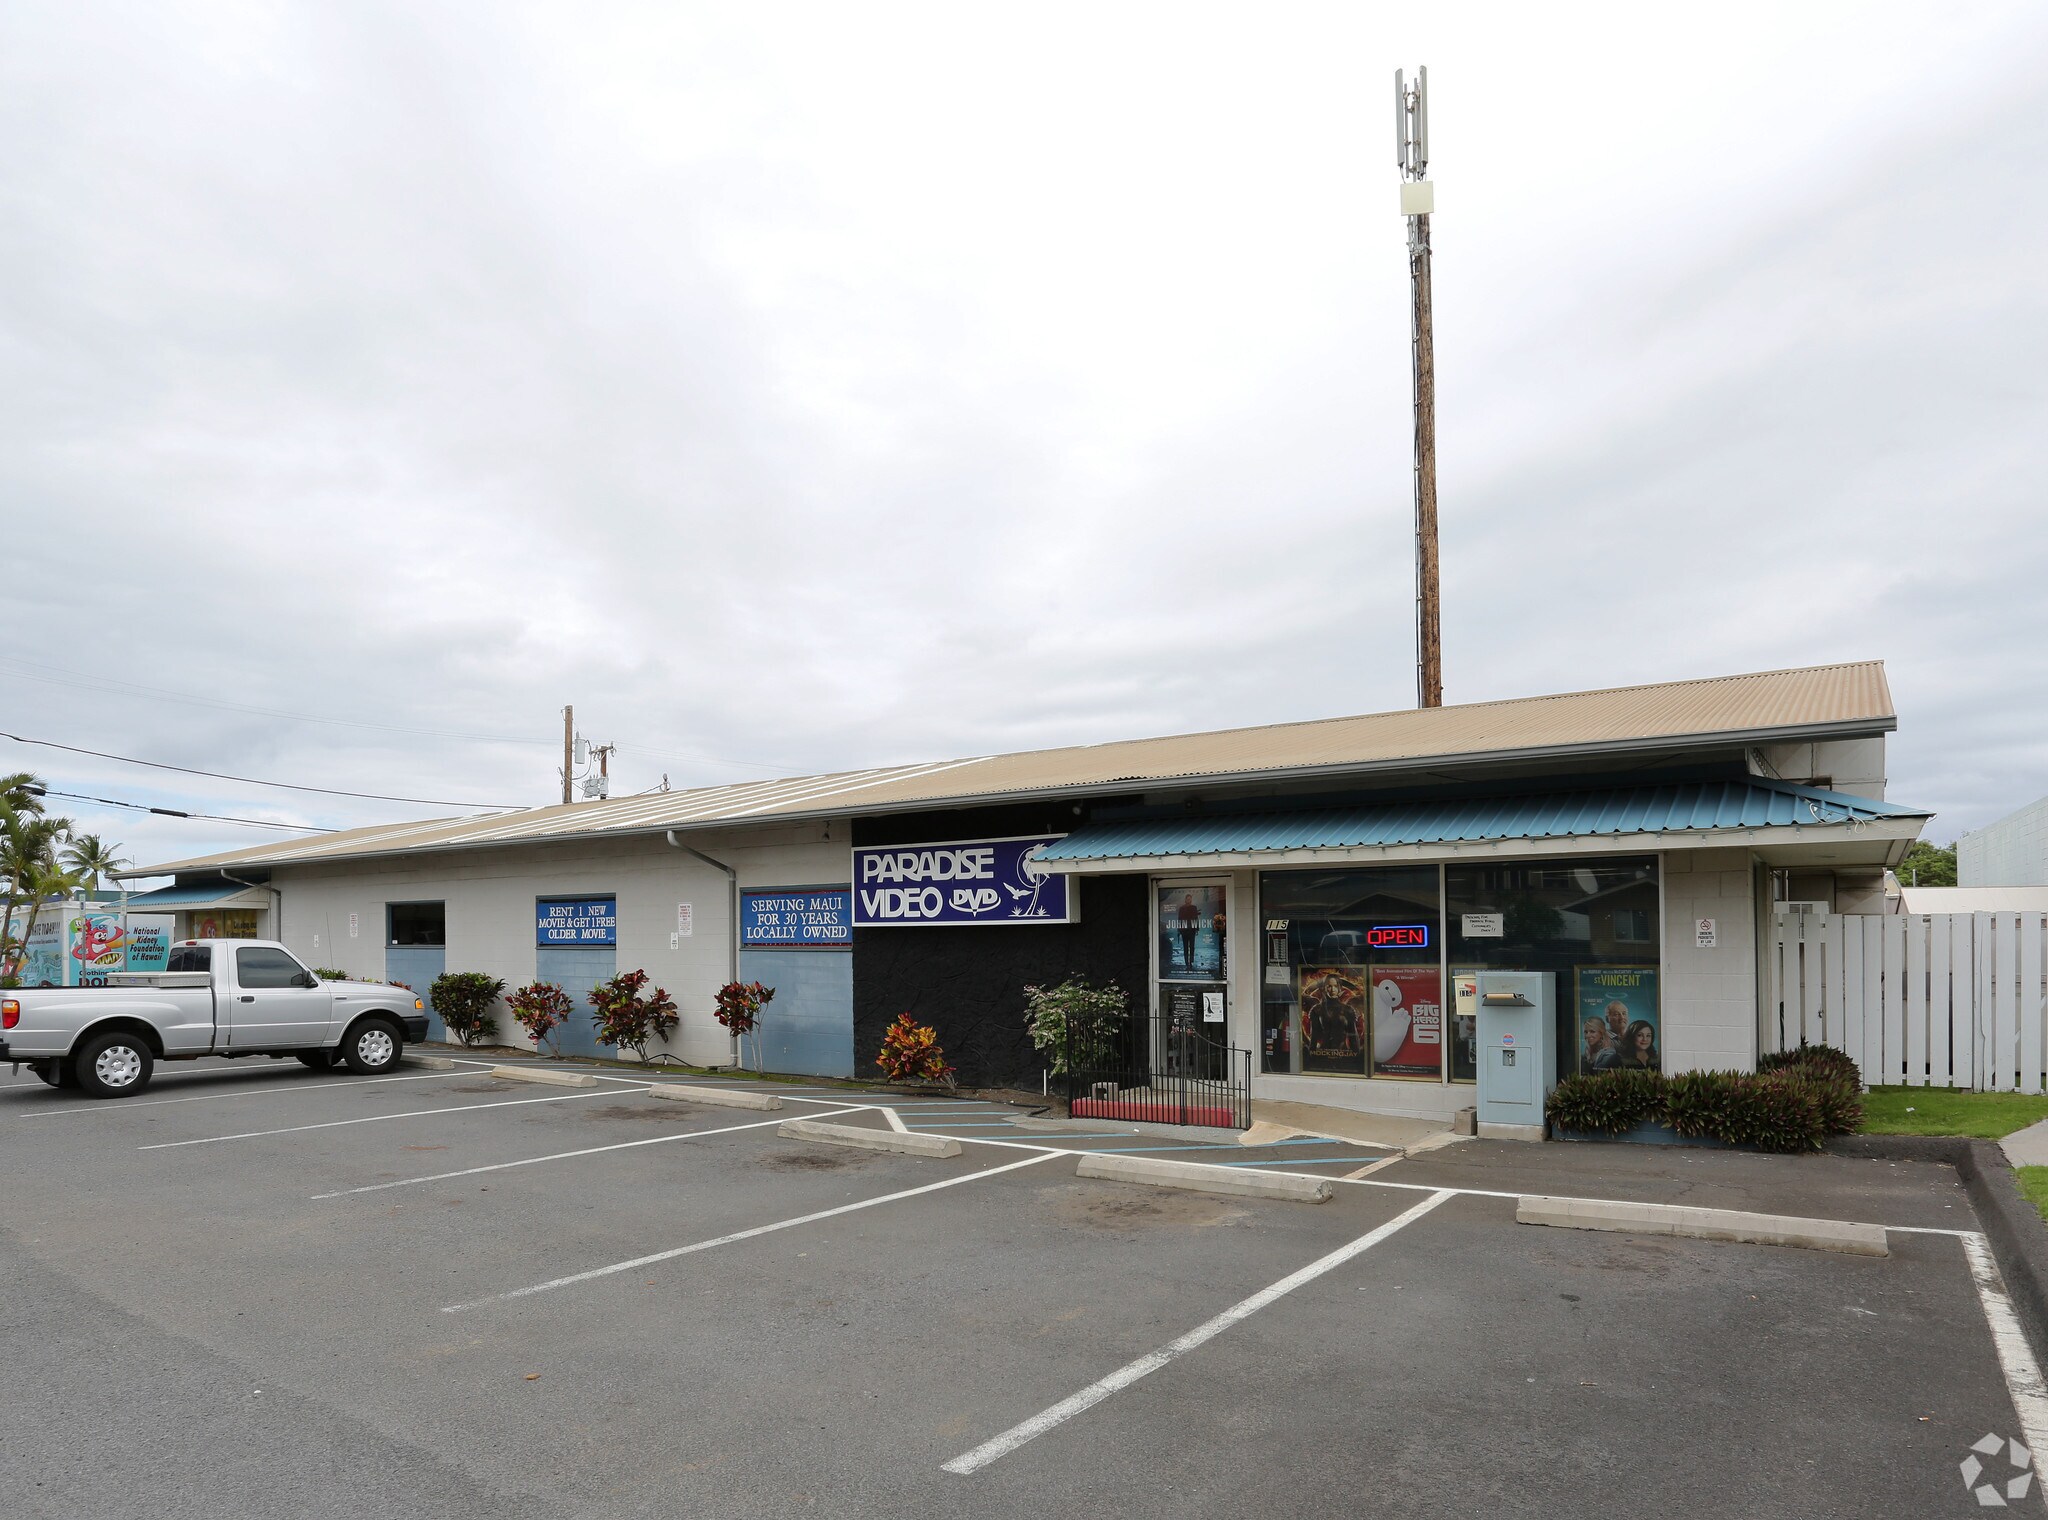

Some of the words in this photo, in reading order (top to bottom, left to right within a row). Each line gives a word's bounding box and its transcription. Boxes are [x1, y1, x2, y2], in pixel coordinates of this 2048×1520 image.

[863, 848, 994, 883] PARADISE
[751, 898, 805, 912] SERVING
[810, 897, 843, 911] MAUI
[860, 887, 943, 918] VIDEO
[949, 888, 1001, 917] DVD
[549, 907, 574, 917] RENT
[588, 905, 606, 916] NEW
[538, 917, 566, 928] MOVIE
[566, 918, 573, 928] &
[573, 917, 591, 928] GET
[596, 916, 616, 927] FREE
[757, 913, 780, 925] FOR
[784, 913, 798, 925] 30
[800, 912, 838, 925] YEARS
[1166, 919, 1188, 929] JOHN
[1191, 919, 1213, 929] WICK
[1269, 920, 1288, 929] 115
[133, 927, 161, 935] National
[548, 929, 577, 940] OLDER
[581, 928, 606, 939] MOVIE
[747, 926, 797, 939] LOCALLY
[803, 926, 847, 938] OWNED
[1367, 929, 1423, 945] OPEN
[136, 936, 158, 945] Kidney
[130, 945, 165, 953] Foundation
[132, 953, 140, 961] of
[141, 952, 163, 961] Hawaii
[1601, 974, 1640, 986] VINCENT
[1412, 1004, 1440, 1016] BIG
[1413, 1024, 1440, 1044] 6
